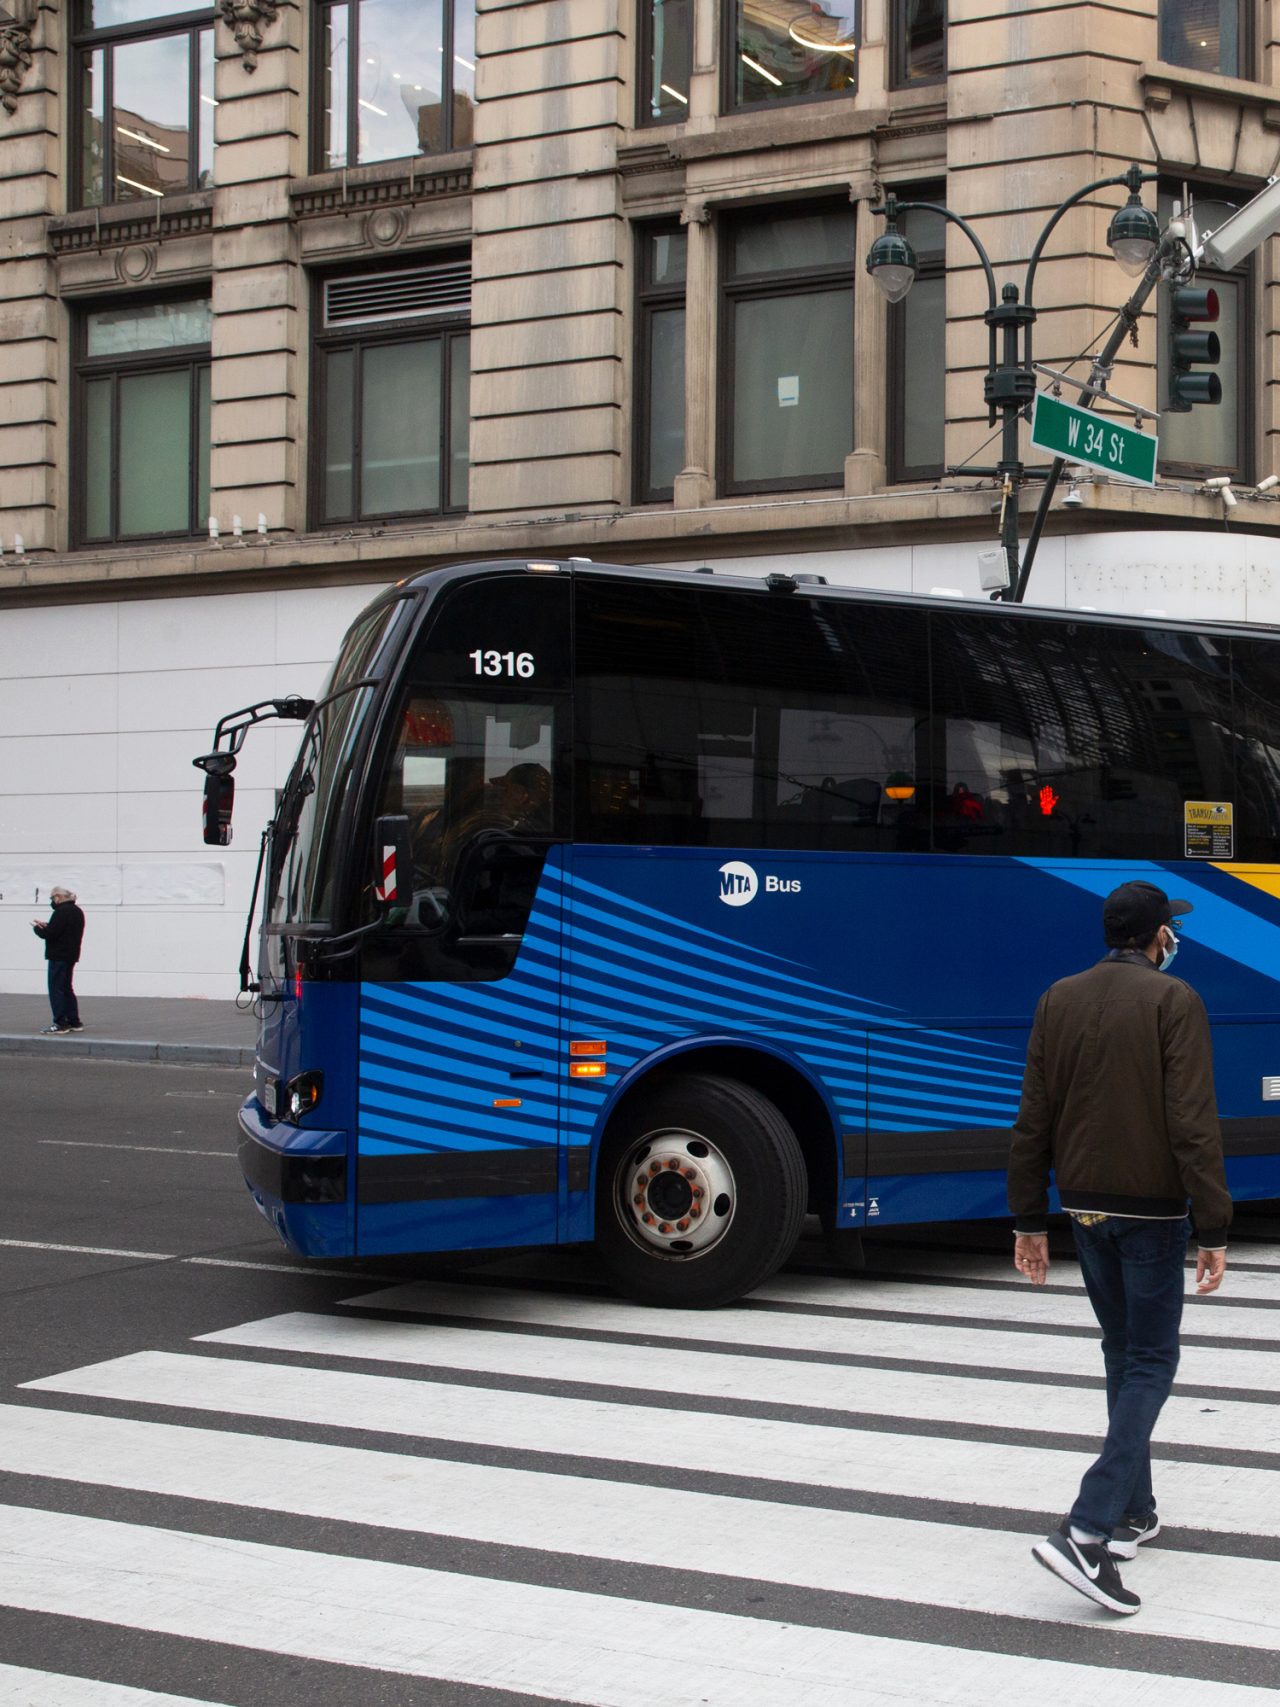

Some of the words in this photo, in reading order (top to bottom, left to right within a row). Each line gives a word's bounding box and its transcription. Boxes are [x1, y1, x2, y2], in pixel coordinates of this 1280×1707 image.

[1068, 416, 1081, 448] W
[1084, 423, 1104, 457] 34
[1108, 432, 1125, 465] St
[469, 649, 535, 678] 1316
[719, 870, 751, 896] MTA
[765, 875, 801, 893] Bus
